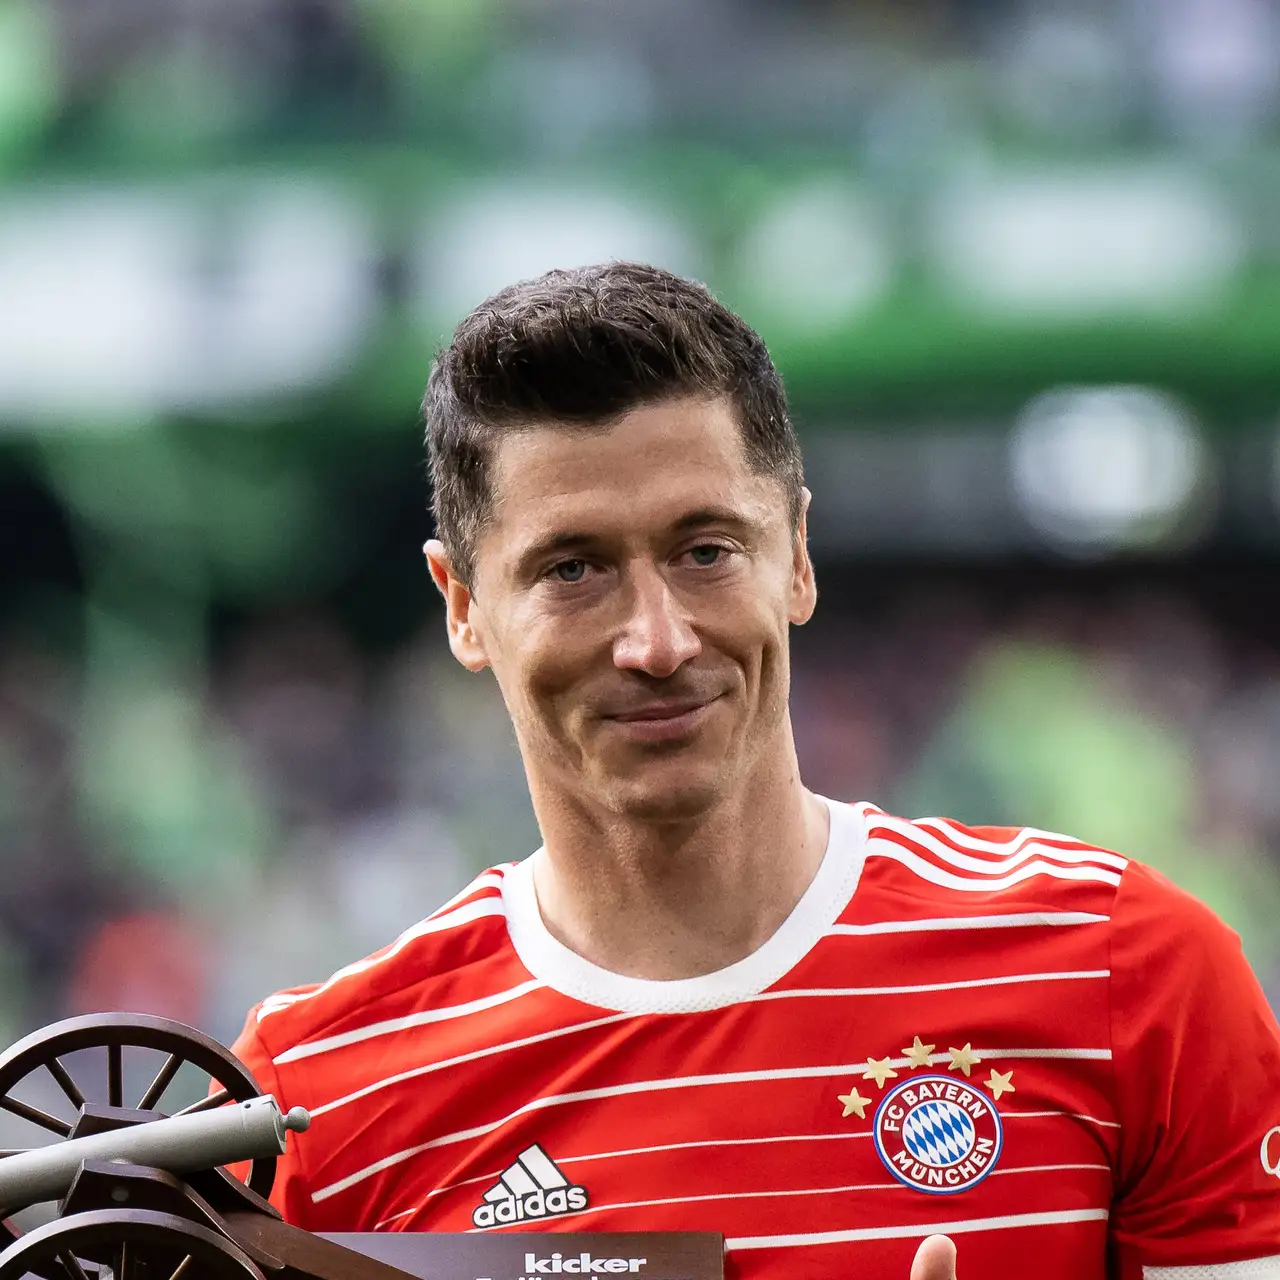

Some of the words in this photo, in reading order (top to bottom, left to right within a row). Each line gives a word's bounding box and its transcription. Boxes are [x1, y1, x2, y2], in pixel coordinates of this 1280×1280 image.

[884, 1104, 905, 1132] FC
[901, 1083, 987, 1119] BAYERN
[892, 1137, 994, 1185] MÜNCHEN
[473, 1187, 587, 1227] adidas
[524, 1253, 647, 1274] kicker
